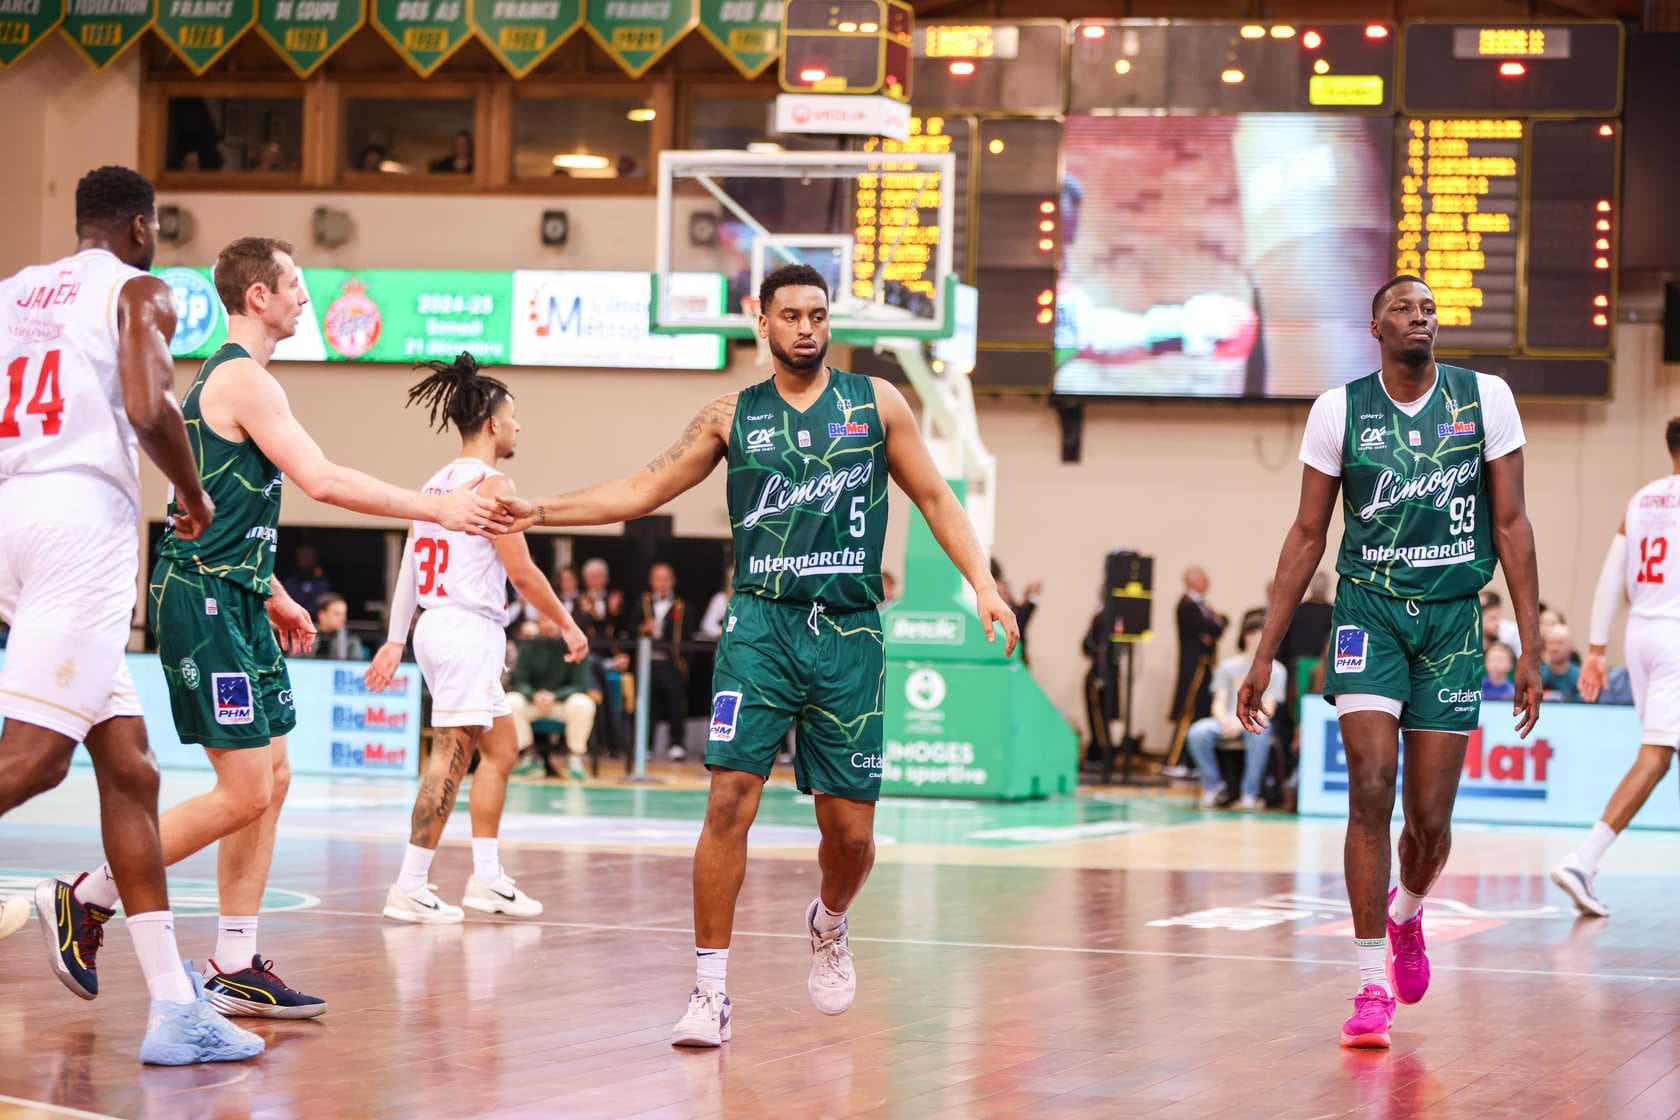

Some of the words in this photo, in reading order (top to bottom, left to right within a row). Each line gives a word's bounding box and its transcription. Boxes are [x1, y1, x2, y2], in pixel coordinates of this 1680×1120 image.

[0, 350, 65, 437] 14
[830, 423, 868, 436] BigMat
[1438, 422, 1475, 435] BigMat
[744, 461, 873, 529] Limoges
[1361, 457, 1479, 521] Limoges
[850, 496, 866, 538] 5
[1449, 494, 1476, 536] 93
[750, 547, 866, 577] Intermarché
[1362, 536, 1475, 564] Intermarché
[1637, 537, 1668, 584] 12
[1336, 658, 1363, 667] PHM
[335, 670, 408, 693] Bigat
[1438, 688, 1482, 703] Catalen
[219, 709, 250, 718] PHM
[333, 706, 407, 730] BigMat
[331, 742, 406, 766] BigMat
[851, 752, 884, 768] Cata
